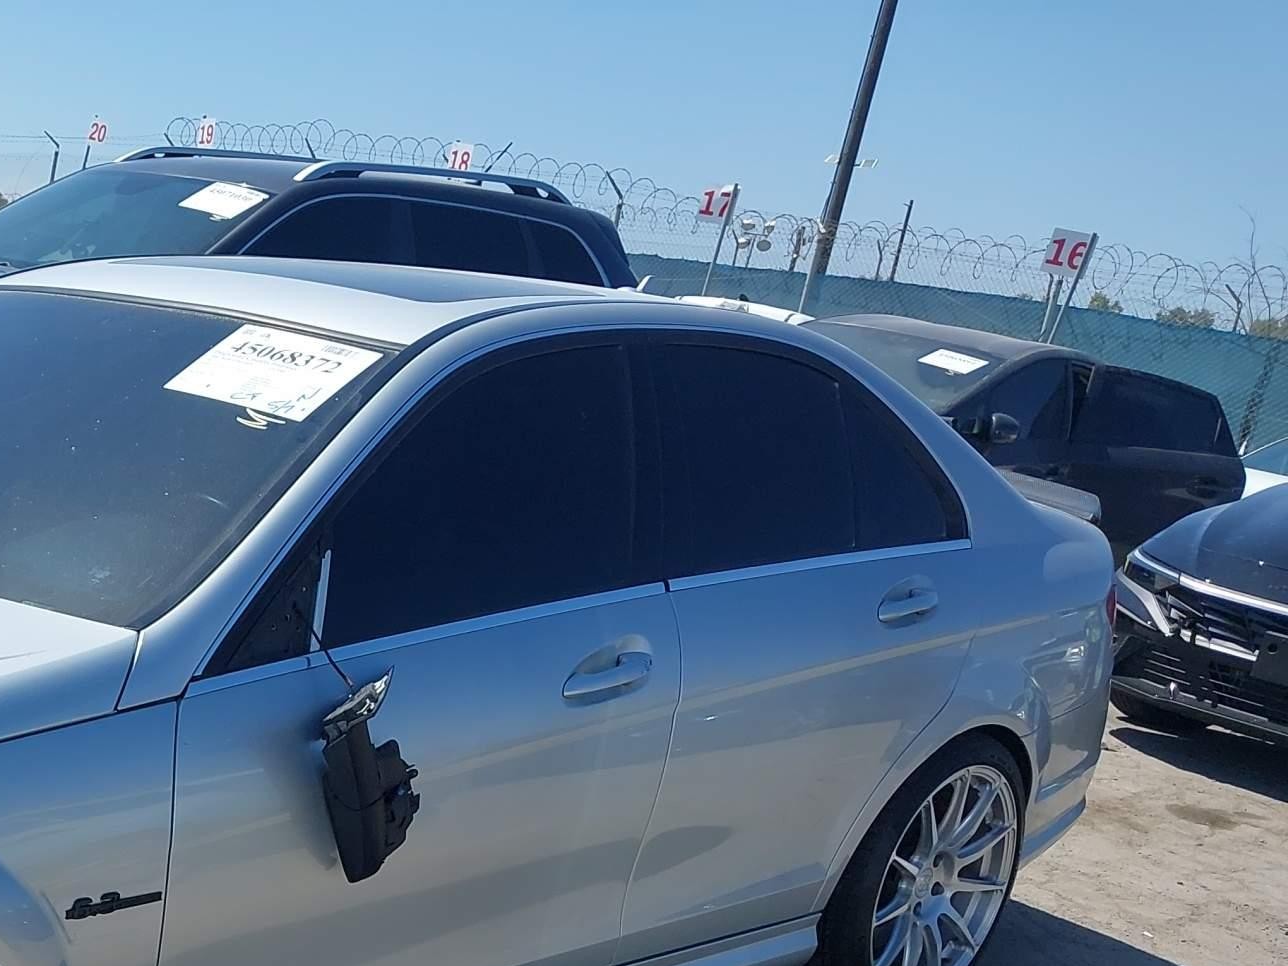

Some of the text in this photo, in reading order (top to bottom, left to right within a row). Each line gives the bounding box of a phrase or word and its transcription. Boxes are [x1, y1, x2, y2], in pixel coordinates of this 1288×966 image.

[88, 122, 107, 143] 20
[199, 124, 214, 145] 19
[449, 150, 471, 171] 18
[698, 190, 732, 218] 17
[1045, 238, 1088, 270] 16
[230, 341, 343, 374] 45068372
